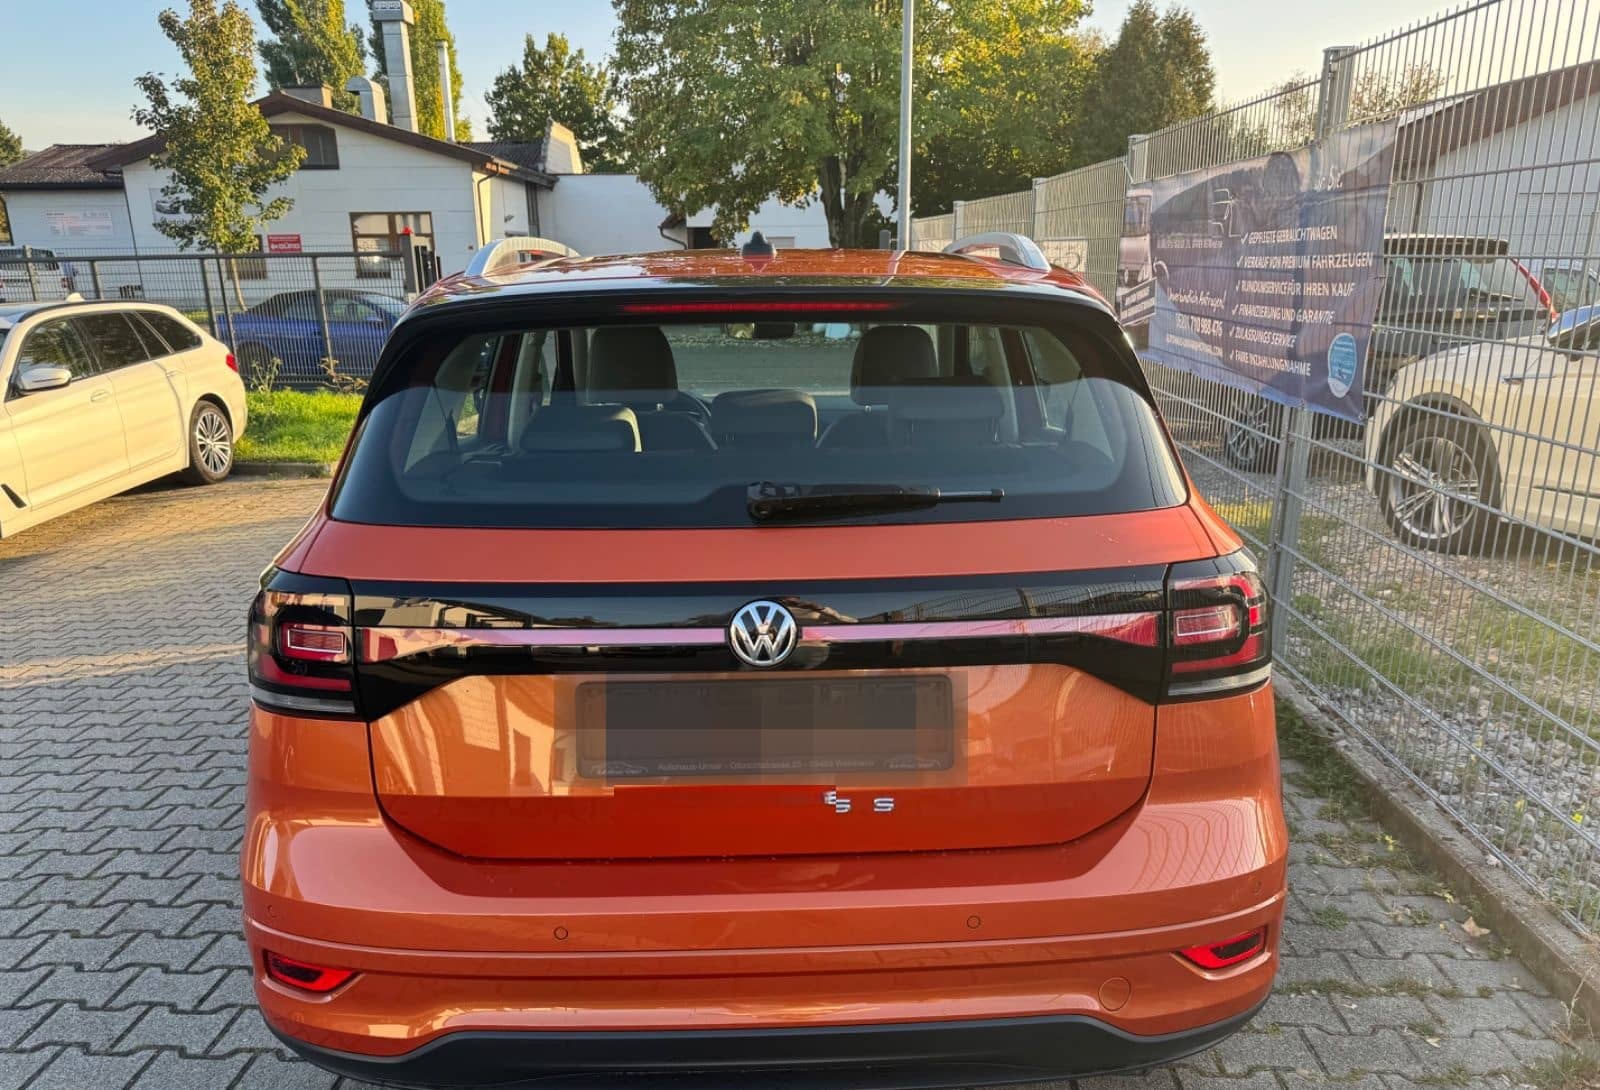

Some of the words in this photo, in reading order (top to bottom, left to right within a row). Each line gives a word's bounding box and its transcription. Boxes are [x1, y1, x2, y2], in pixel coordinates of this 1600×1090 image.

[1277, 225, 1338, 242] GEBRAUCHTWAGEN
[1311, 252, 1374, 269] FAHRZEUGEN
[1303, 282, 1329, 296] IHREN
[1331, 282, 1356, 297] KAUF
[1281, 306, 1296, 322] UND
[1296, 308, 1336, 325] GARANTIE
[1271, 332, 1297, 348] SERVICE
